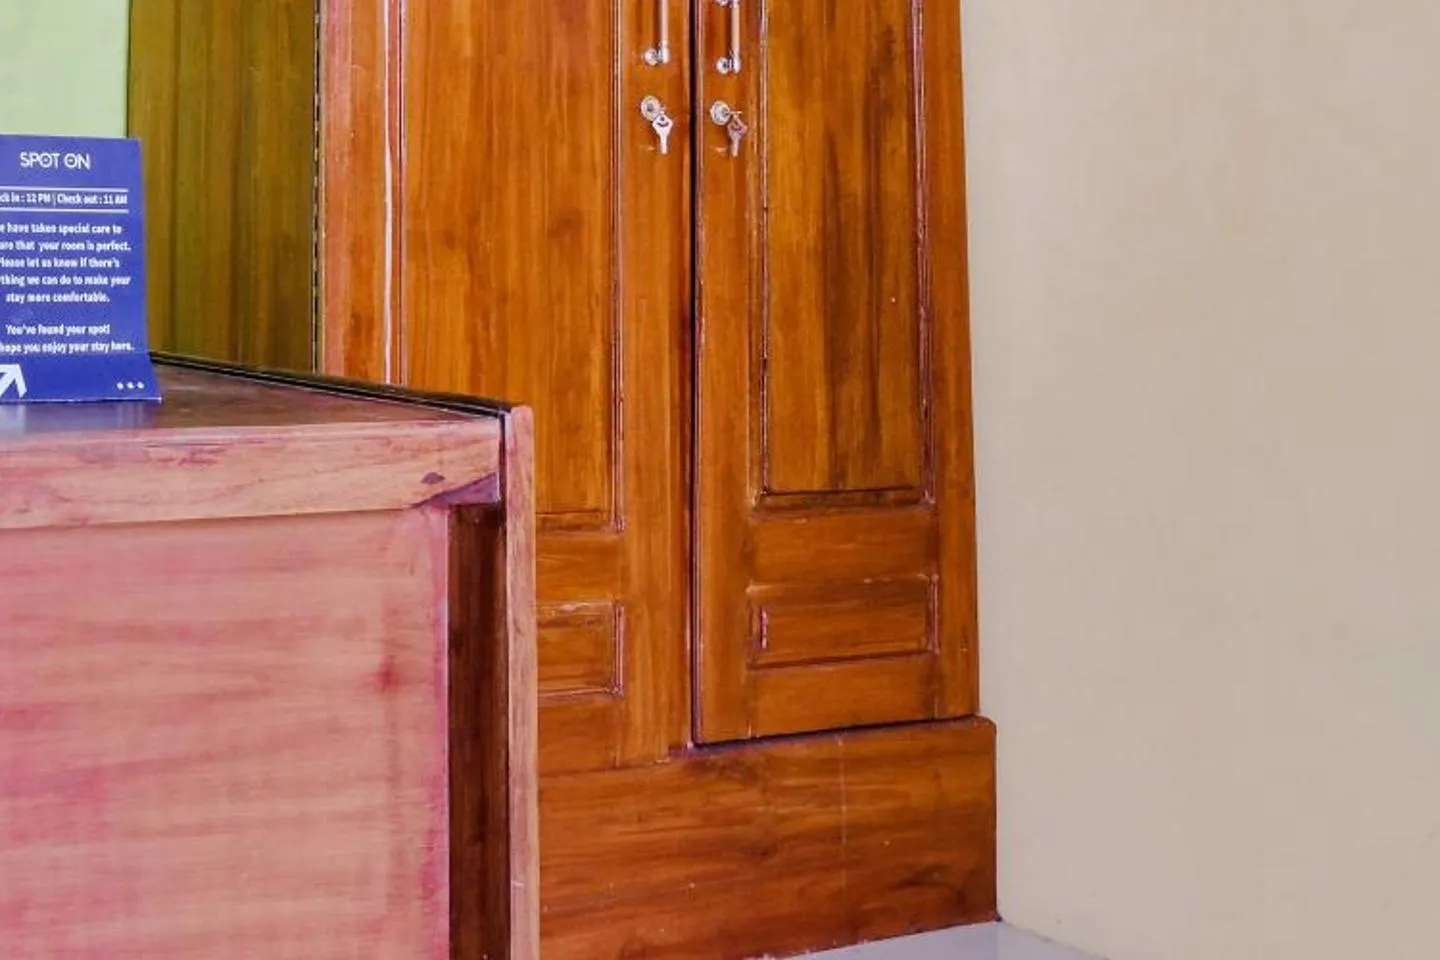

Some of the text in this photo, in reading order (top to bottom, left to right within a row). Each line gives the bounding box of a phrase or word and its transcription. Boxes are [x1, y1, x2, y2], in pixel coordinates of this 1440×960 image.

[20, 152, 92, 170] SPOT ON
[11, 192, 20, 203] in
[57, 193, 83, 204] Check
[83, 195, 98, 205] out
[7, 222, 29, 233] have
[31, 222, 57, 233] taken
[58, 222, 90, 236] special
[92, 226, 110, 234] care
[112, 224, 122, 234] to
[15, 240, 35, 250] that
[38, 241, 60, 252] your
[61, 242, 85, 251] room
[86, 240, 94, 251] is
[96, 240, 131, 253] perfect.
[26, 257, 39, 268] let
[41, 259, 52, 268] us
[53, 256, 78, 268] know
[80, 257, 87, 267] if
[88, 257, 120, 268] there's
[27, 276, 40, 285] we
[42, 276, 58, 285] can
[59, 274, 71, 285] do
[73, 276, 83, 285] to
[84, 274, 108, 285] make
[110, 276, 131, 288] your
[6, 291, 110, 304] stay more comfortable.
[6, 324, 110, 336] You've found your spot!
[23, 343, 41, 354] you
[42, 340, 67, 354] enjoy
[68, 343, 90, 354] your
[90, 340, 110, 354] stay
[111, 340, 135, 352] here.
